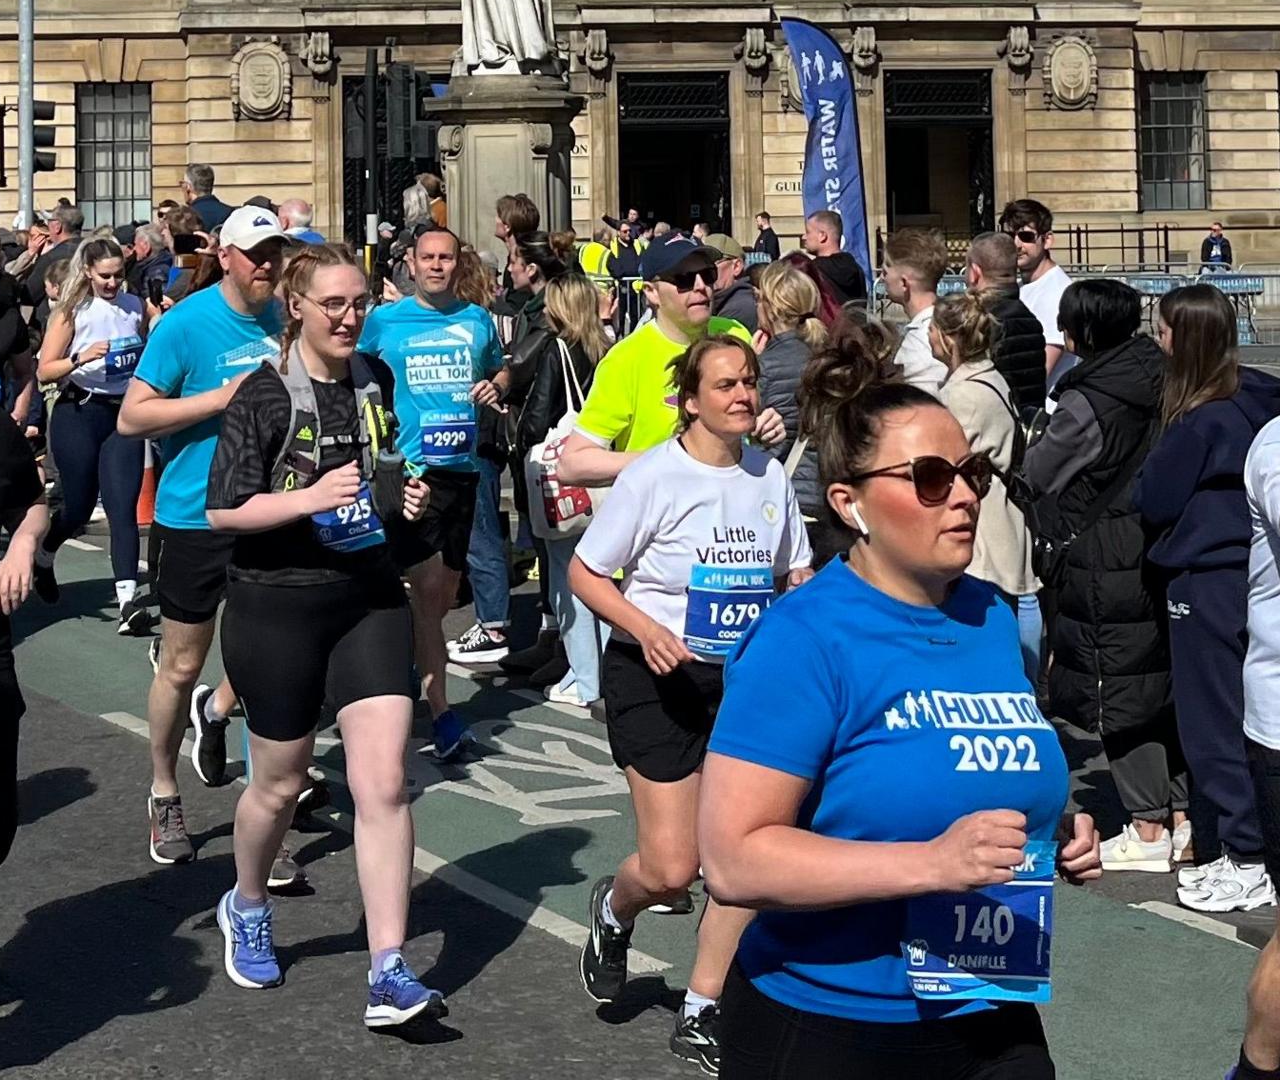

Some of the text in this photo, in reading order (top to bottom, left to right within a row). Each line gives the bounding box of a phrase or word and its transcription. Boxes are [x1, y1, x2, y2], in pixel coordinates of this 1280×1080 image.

[775, 181, 802, 191] GUIL
[409, 368, 469, 381] HULL 10K
[336, 498, 371, 524] 925
[713, 525, 756, 544] Little
[696, 545, 773, 564] Victories
[723, 574, 749, 586] HULL
[938, 696, 1012, 725] HULL
[949, 735, 1041, 772] 2022
[954, 905, 1015, 945] 140
[948, 954, 1007, 969] DANIELLE
[939, 984, 952, 992] ALL
